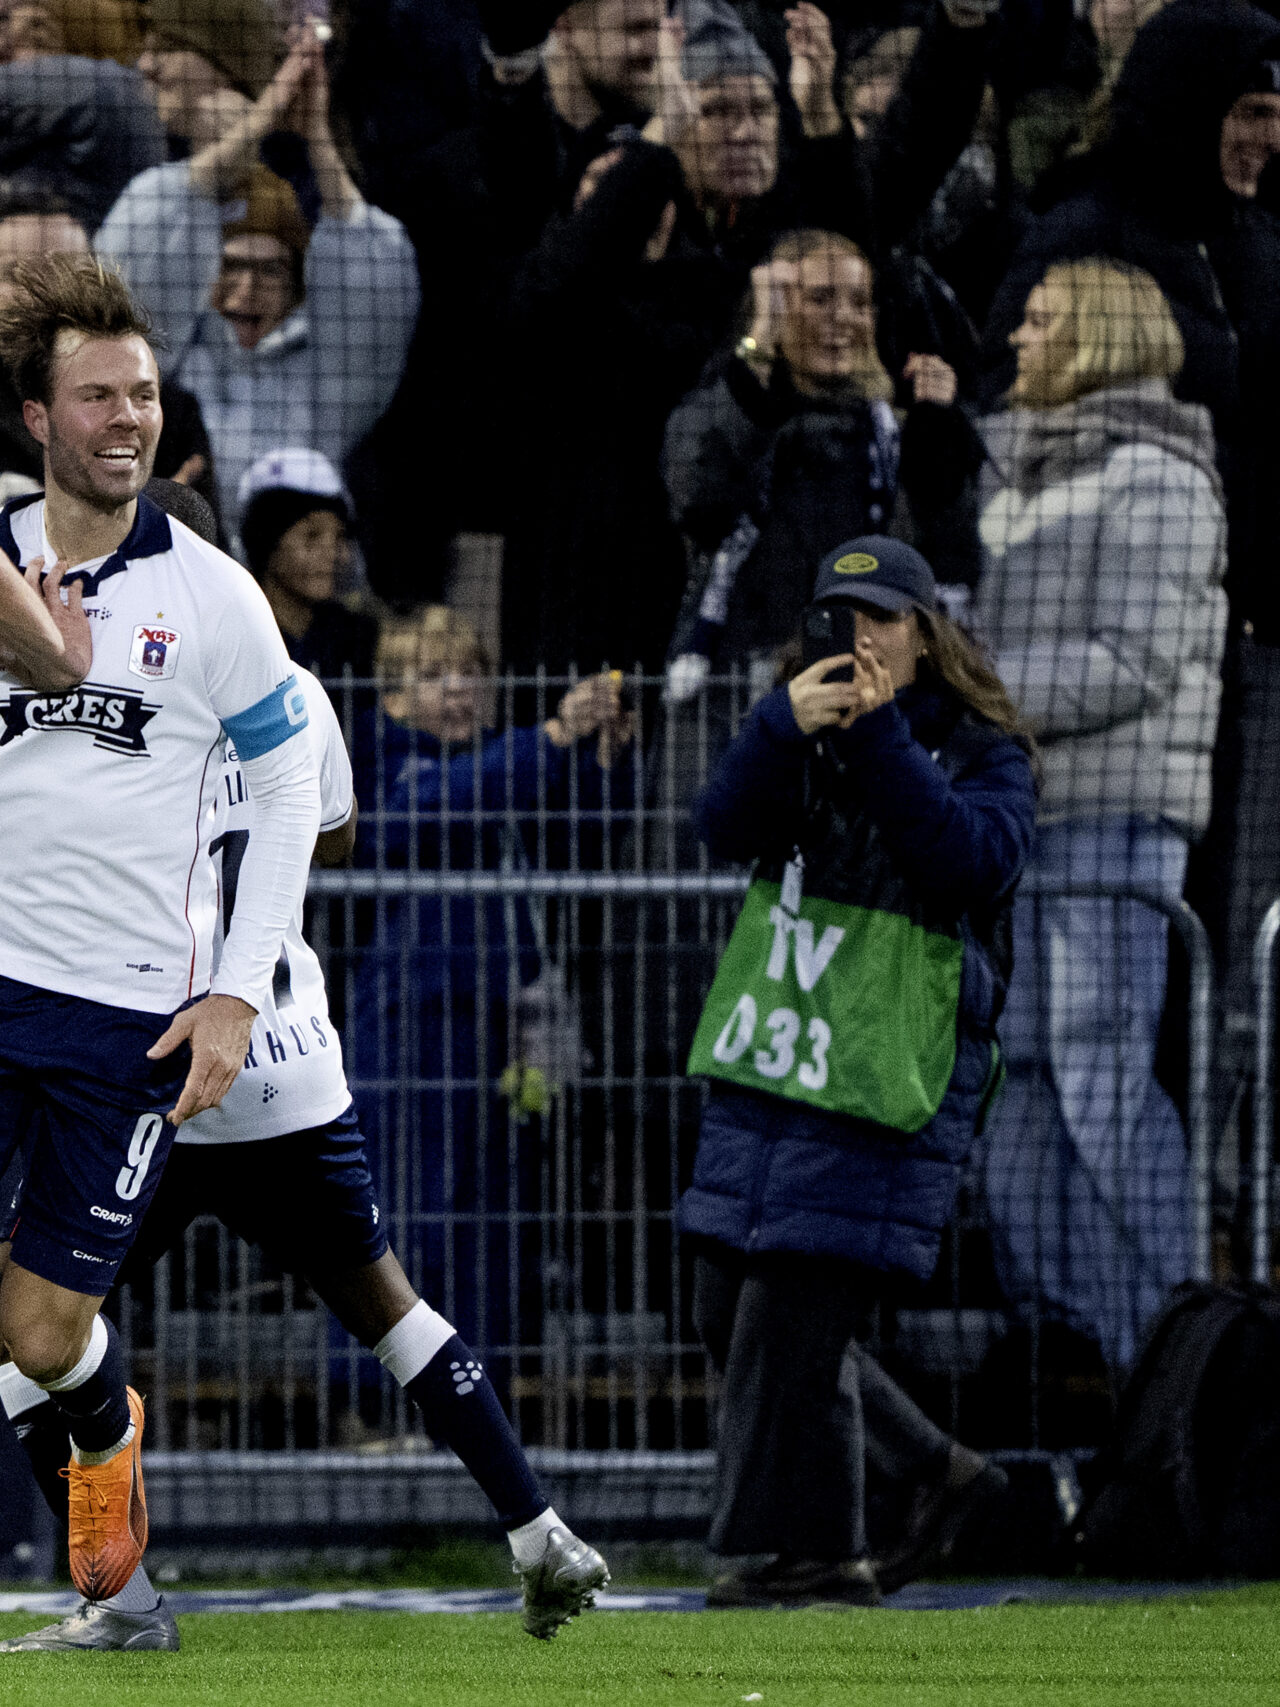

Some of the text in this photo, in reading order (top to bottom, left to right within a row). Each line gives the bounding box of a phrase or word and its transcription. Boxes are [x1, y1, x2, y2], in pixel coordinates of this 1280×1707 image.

[766, 904, 846, 993] TV
[115, 1112, 164, 1200] 9
[89, 1205, 127, 1225] CRAFT
